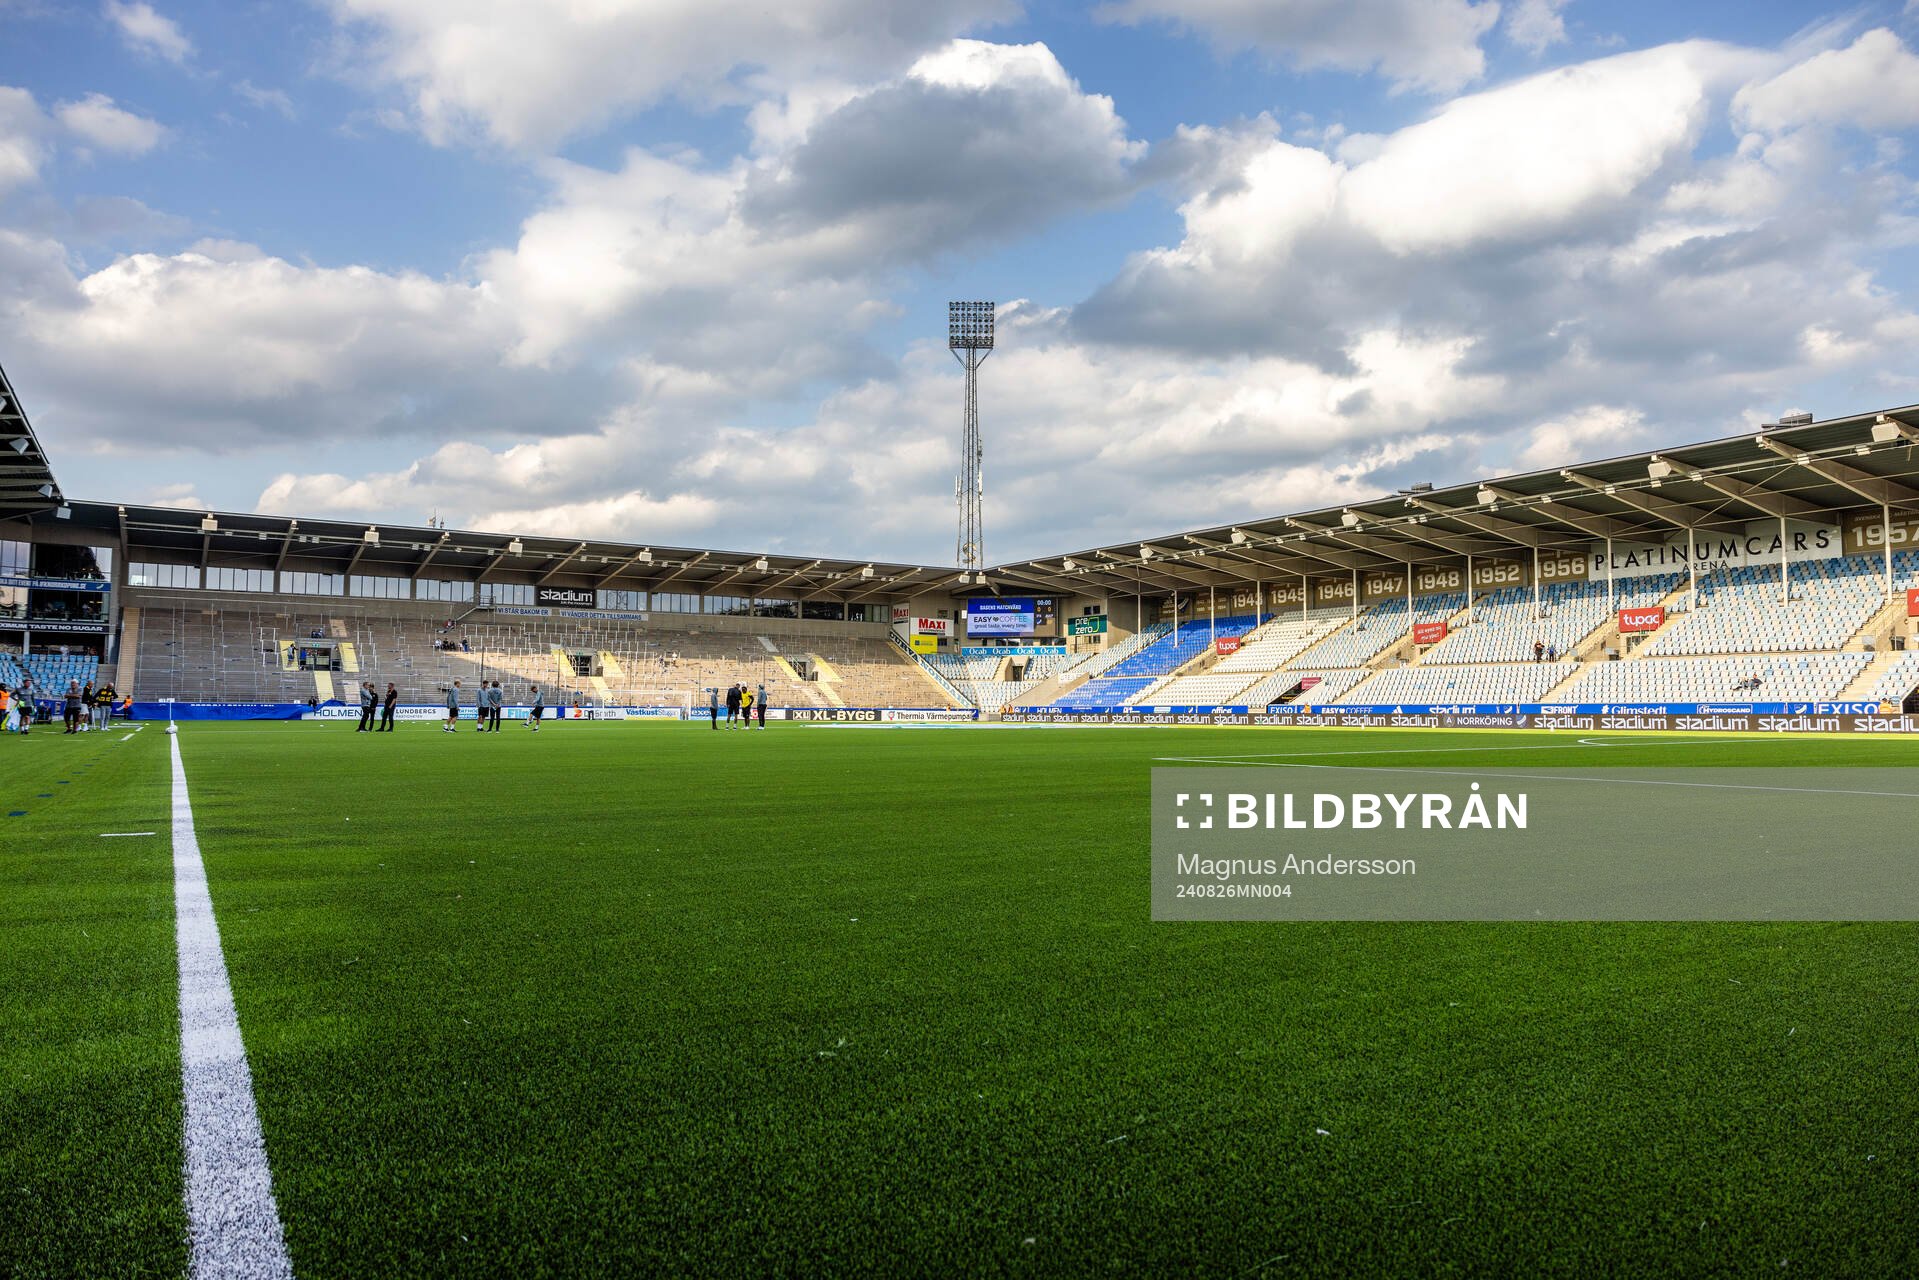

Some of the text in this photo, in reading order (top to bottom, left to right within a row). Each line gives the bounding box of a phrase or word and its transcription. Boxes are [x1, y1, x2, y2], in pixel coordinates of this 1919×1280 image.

[1682, 560, 1728, 575] ARENA
[1473, 565, 1520, 584] 1952
[1366, 577, 1403, 595] 1947
[1417, 571, 1460, 590] 1948
[540, 589, 593, 602] stadium
[1272, 588, 1305, 605] 1945
[1318, 583, 1354, 600] 1946
[894, 608, 909, 619] MAXI
[918, 618, 946, 630] MAXI
[1075, 617, 1088, 628] pre
[1624, 614, 1661, 631] tupac
[1075, 626, 1093, 634] zero
[314, 709, 363, 717] HOLMEN
[1270, 706, 1293, 714] EXISO
[1612, 705, 1667, 714] Glimstedt
[1818, 703, 1880, 714] EXISO
[813, 711, 876, 720] XL-BYGG
[1002, 713, 1024, 722] stadium
[1027, 713, 1052, 722] stadium
[1053, 713, 1079, 723] stadium
[1081, 713, 1109, 723] stadium
[1112, 714, 1141, 723] stadium
[1144, 714, 1174, 723] stadium
[1177, 714, 1210, 724] stadium
[1213, 714, 1249, 724] stadium
[1254, 715, 1293, 725] stadium
[1297, 714, 1337, 725] stadium
[1341, 715, 1386, 726] stadium
[1391, 715, 1439, 727] stadium
[1457, 716, 1513, 725] NORRKÖPING
[1534, 715, 1594, 728] stadium
[1601, 715, 1668, 729] stadium
[1675, 715, 1749, 730] stadium
[1758, 716, 1841, 731] stadium
